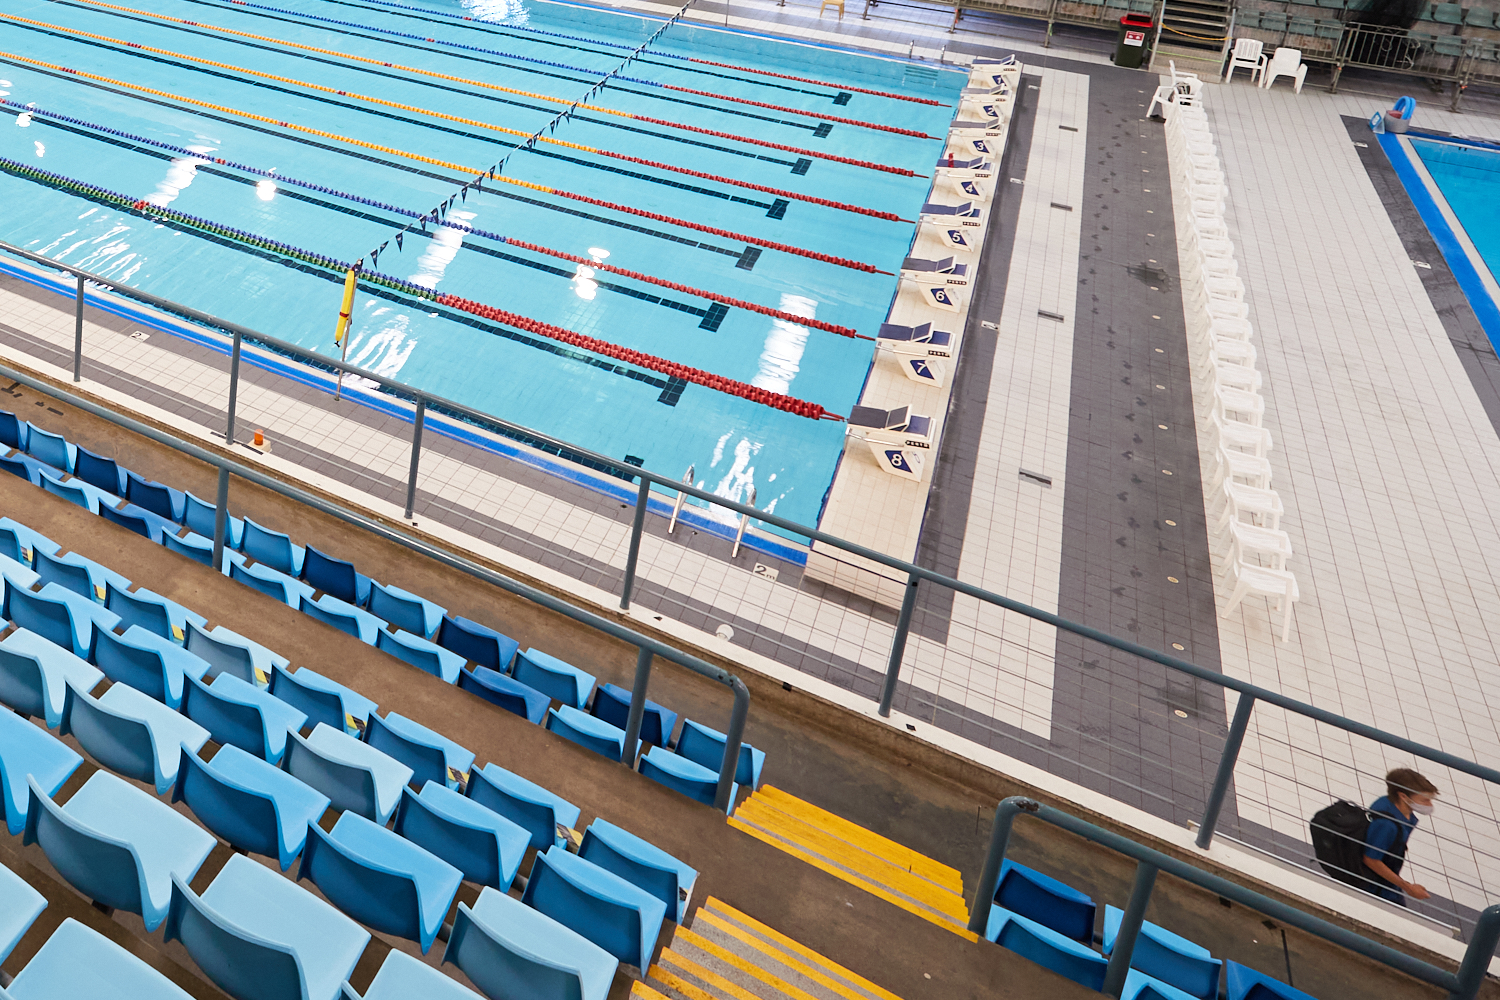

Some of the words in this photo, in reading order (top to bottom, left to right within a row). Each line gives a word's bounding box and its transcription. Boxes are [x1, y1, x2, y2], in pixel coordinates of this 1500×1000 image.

[986, 107, 994, 116] 2
[975, 141, 985, 151] 3
[965, 182, 975, 194] 4
[951, 231, 962, 242] 5
[935, 290, 945, 302] 6
[916, 360, 927, 374] 7
[891, 453, 903, 467] 8
[754, 564, 775, 580] 2m
